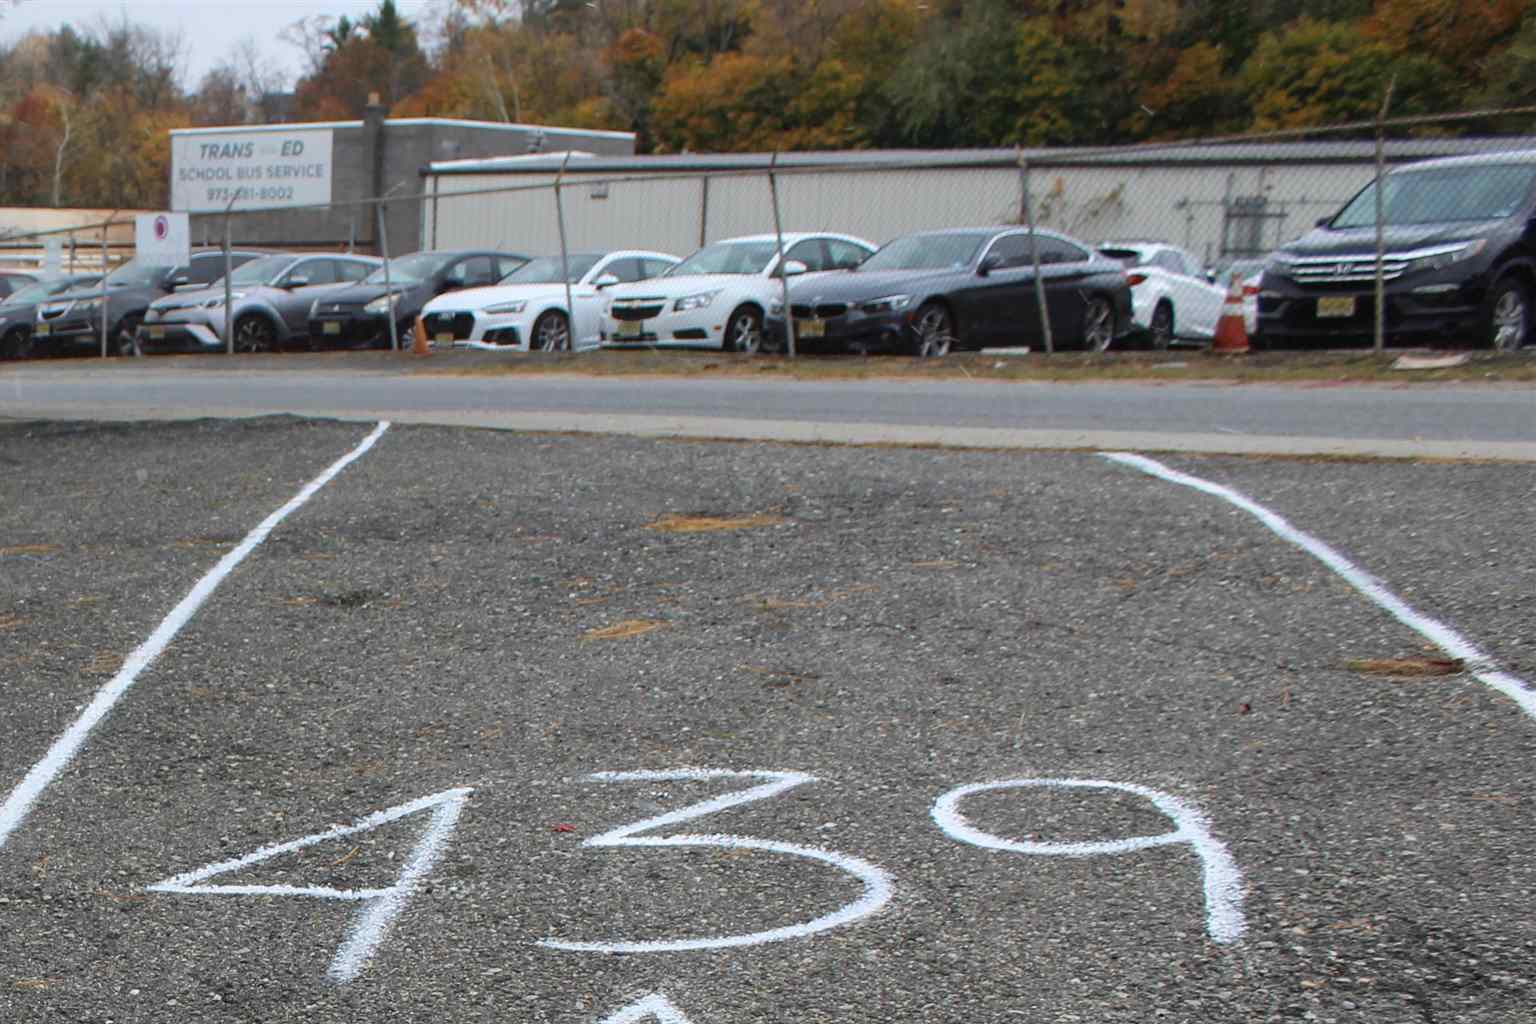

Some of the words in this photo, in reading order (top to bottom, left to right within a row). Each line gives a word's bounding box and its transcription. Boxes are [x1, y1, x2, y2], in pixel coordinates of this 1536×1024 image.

[199, 142, 255, 160] TRANS
[280, 139, 305, 158] ED
[178, 167, 233, 182] SCHOOL
[237, 165, 263, 180] BUS
[266, 163, 325, 179] SERVICE
[142, 767, 1249, 984] 439
